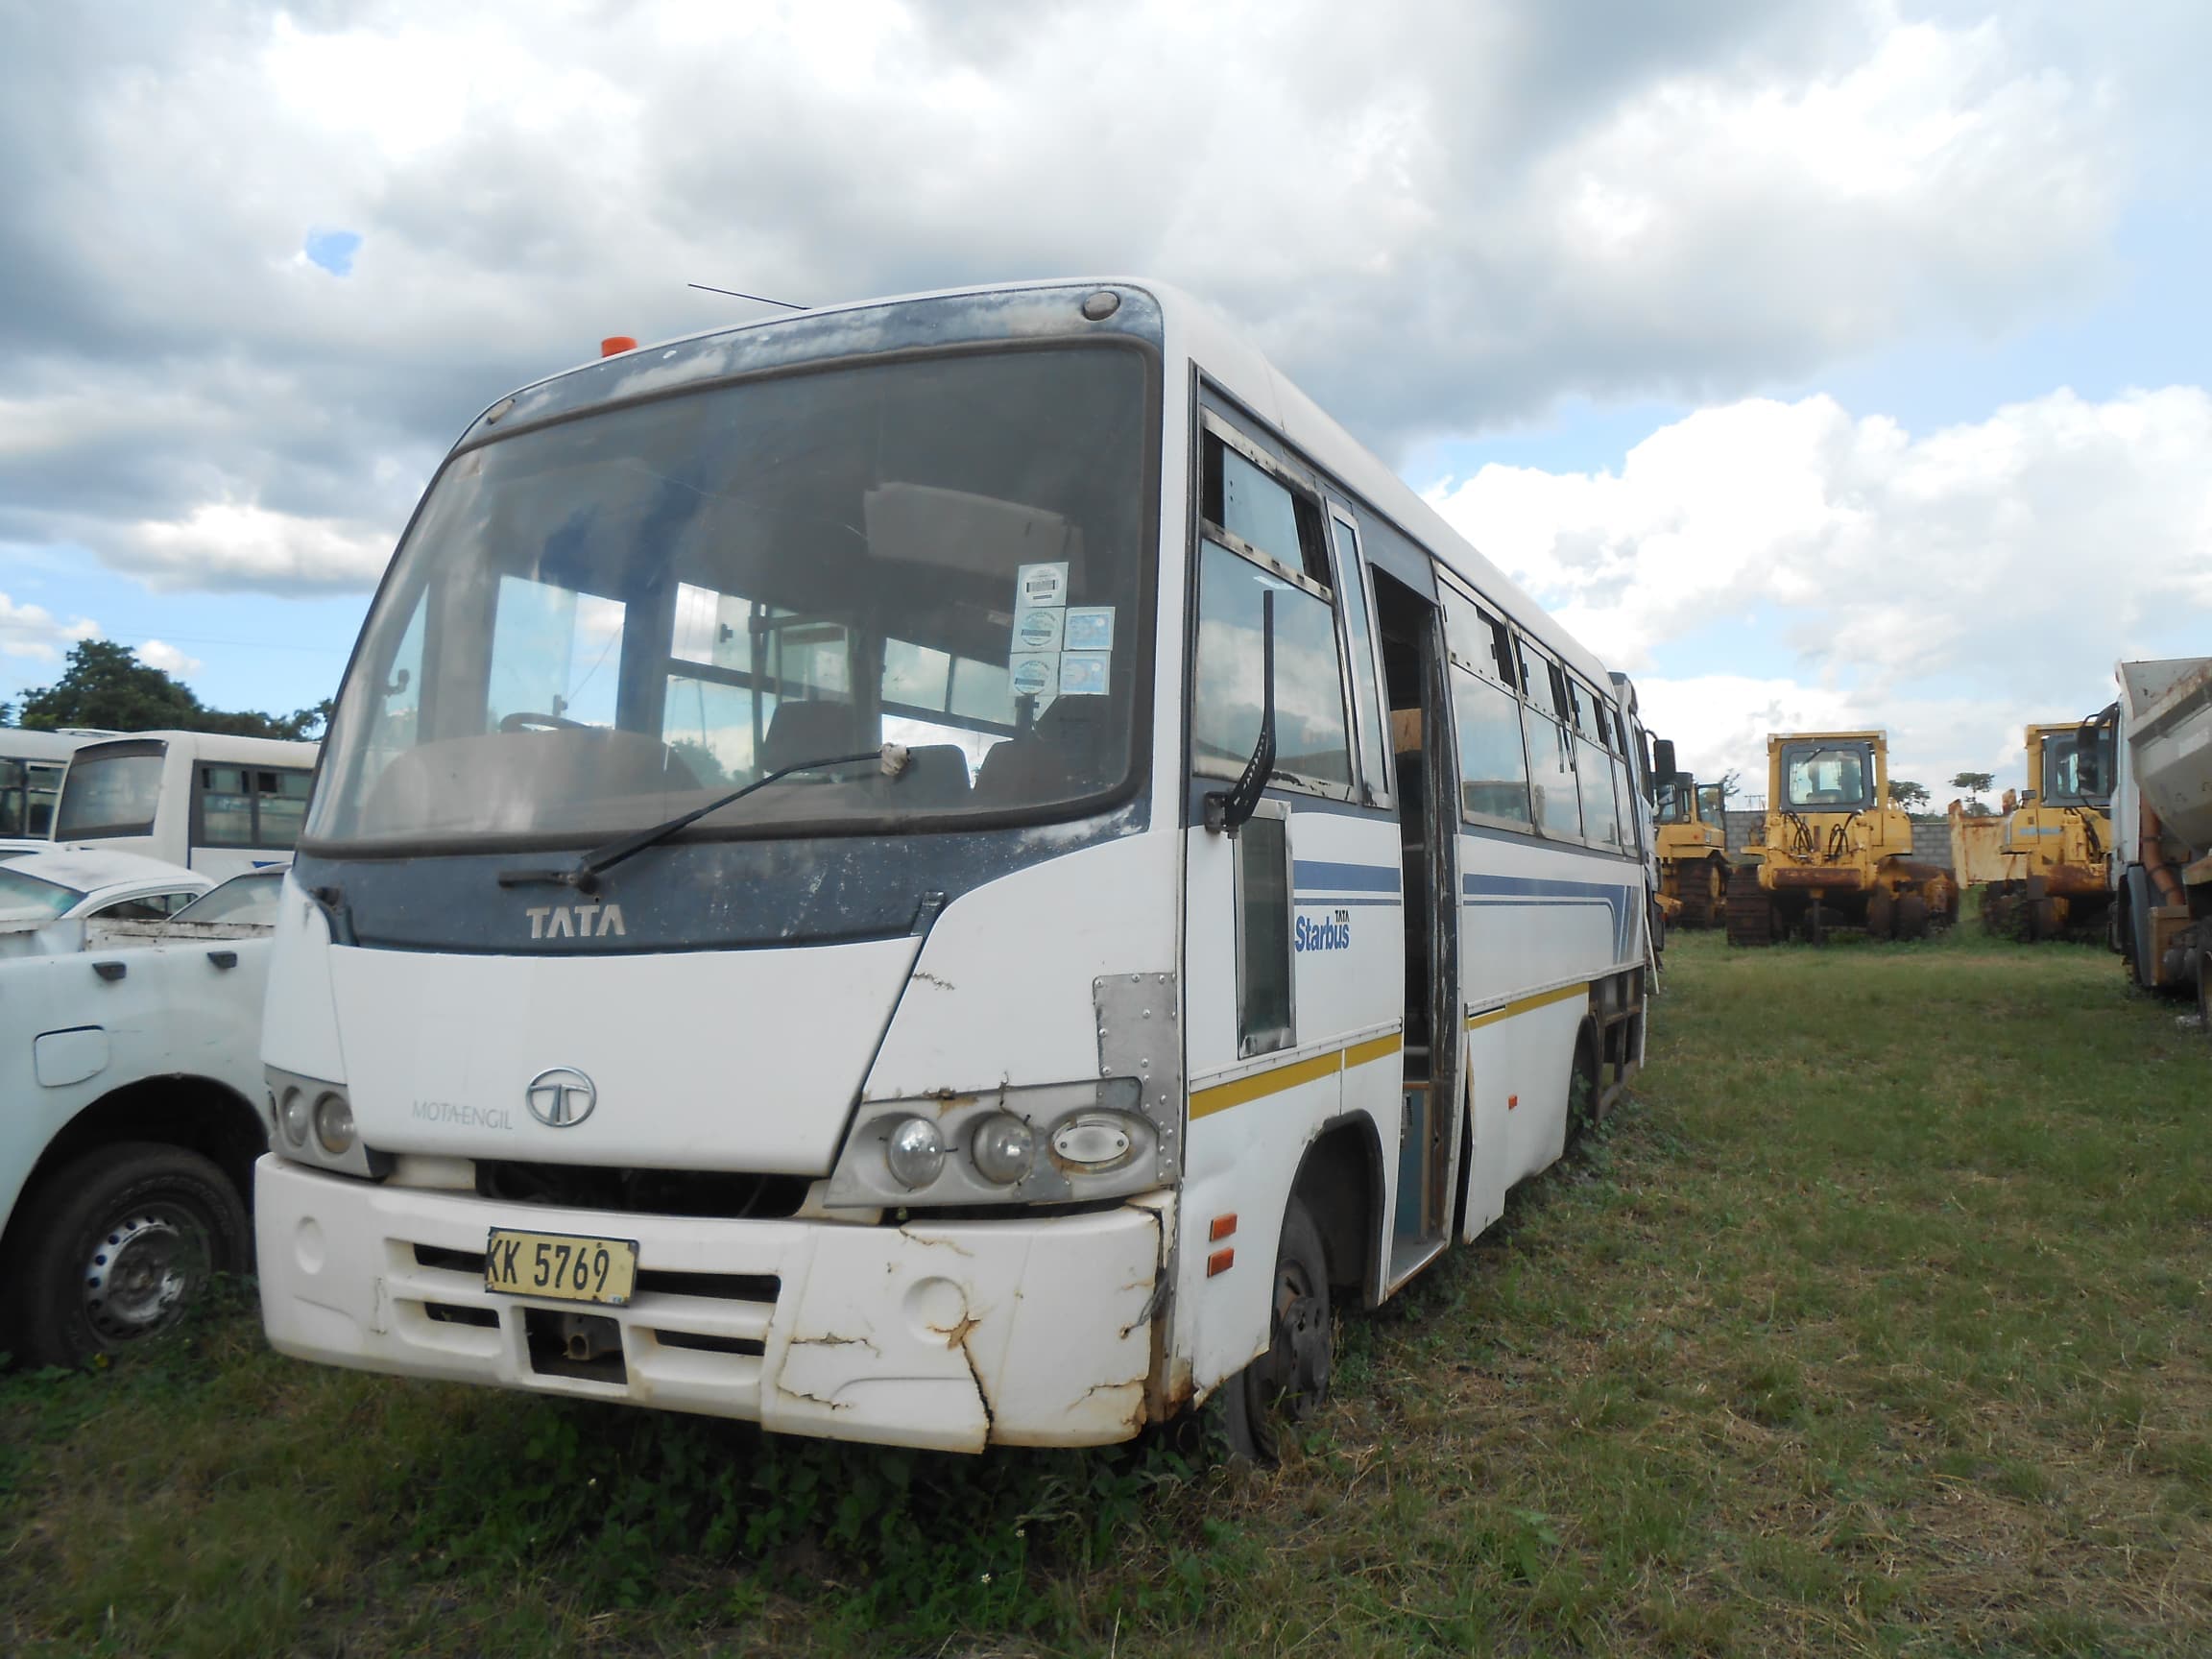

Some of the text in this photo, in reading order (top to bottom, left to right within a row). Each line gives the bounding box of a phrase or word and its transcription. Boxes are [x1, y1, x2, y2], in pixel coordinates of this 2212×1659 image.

[526, 904, 626, 939] TATA
[1294, 915, 1350, 952] Starbus
[1334, 909, 1350, 923] TATA
[484, 1238, 610, 1293] KK 5769
